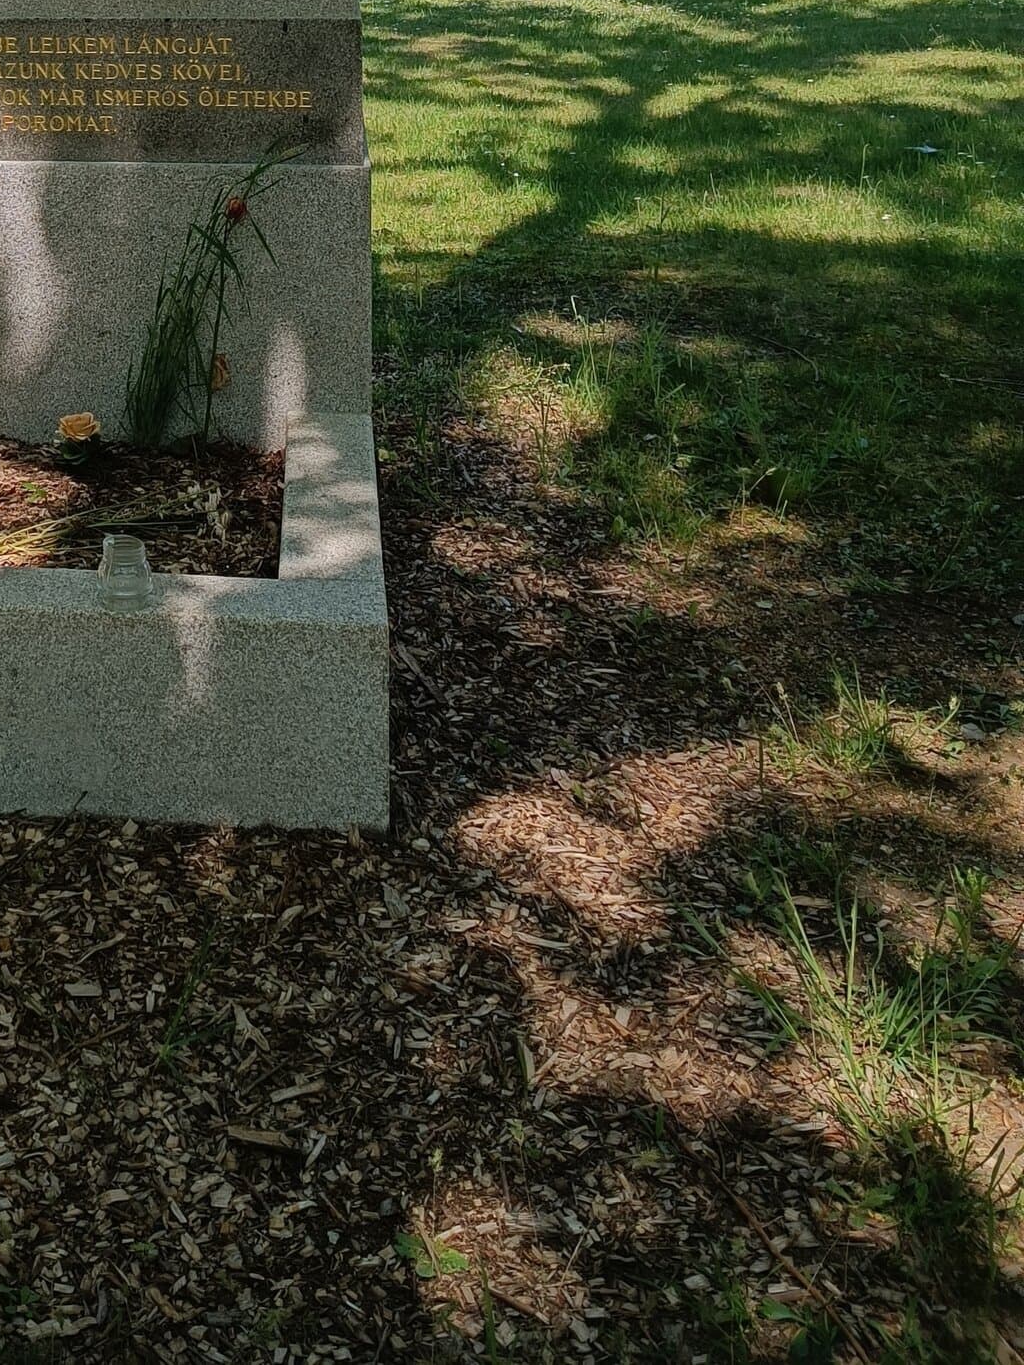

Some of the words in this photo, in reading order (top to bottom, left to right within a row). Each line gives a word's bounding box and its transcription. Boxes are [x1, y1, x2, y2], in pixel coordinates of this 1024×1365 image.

[29, 36, 115, 55] LELKEM
[76, 64, 162, 80] KEDVES
[40, 83, 86, 106] MÁR
[95, 84, 189, 107] ISMERŐS
[198, 87, 312, 108] ÖLETEKBE
